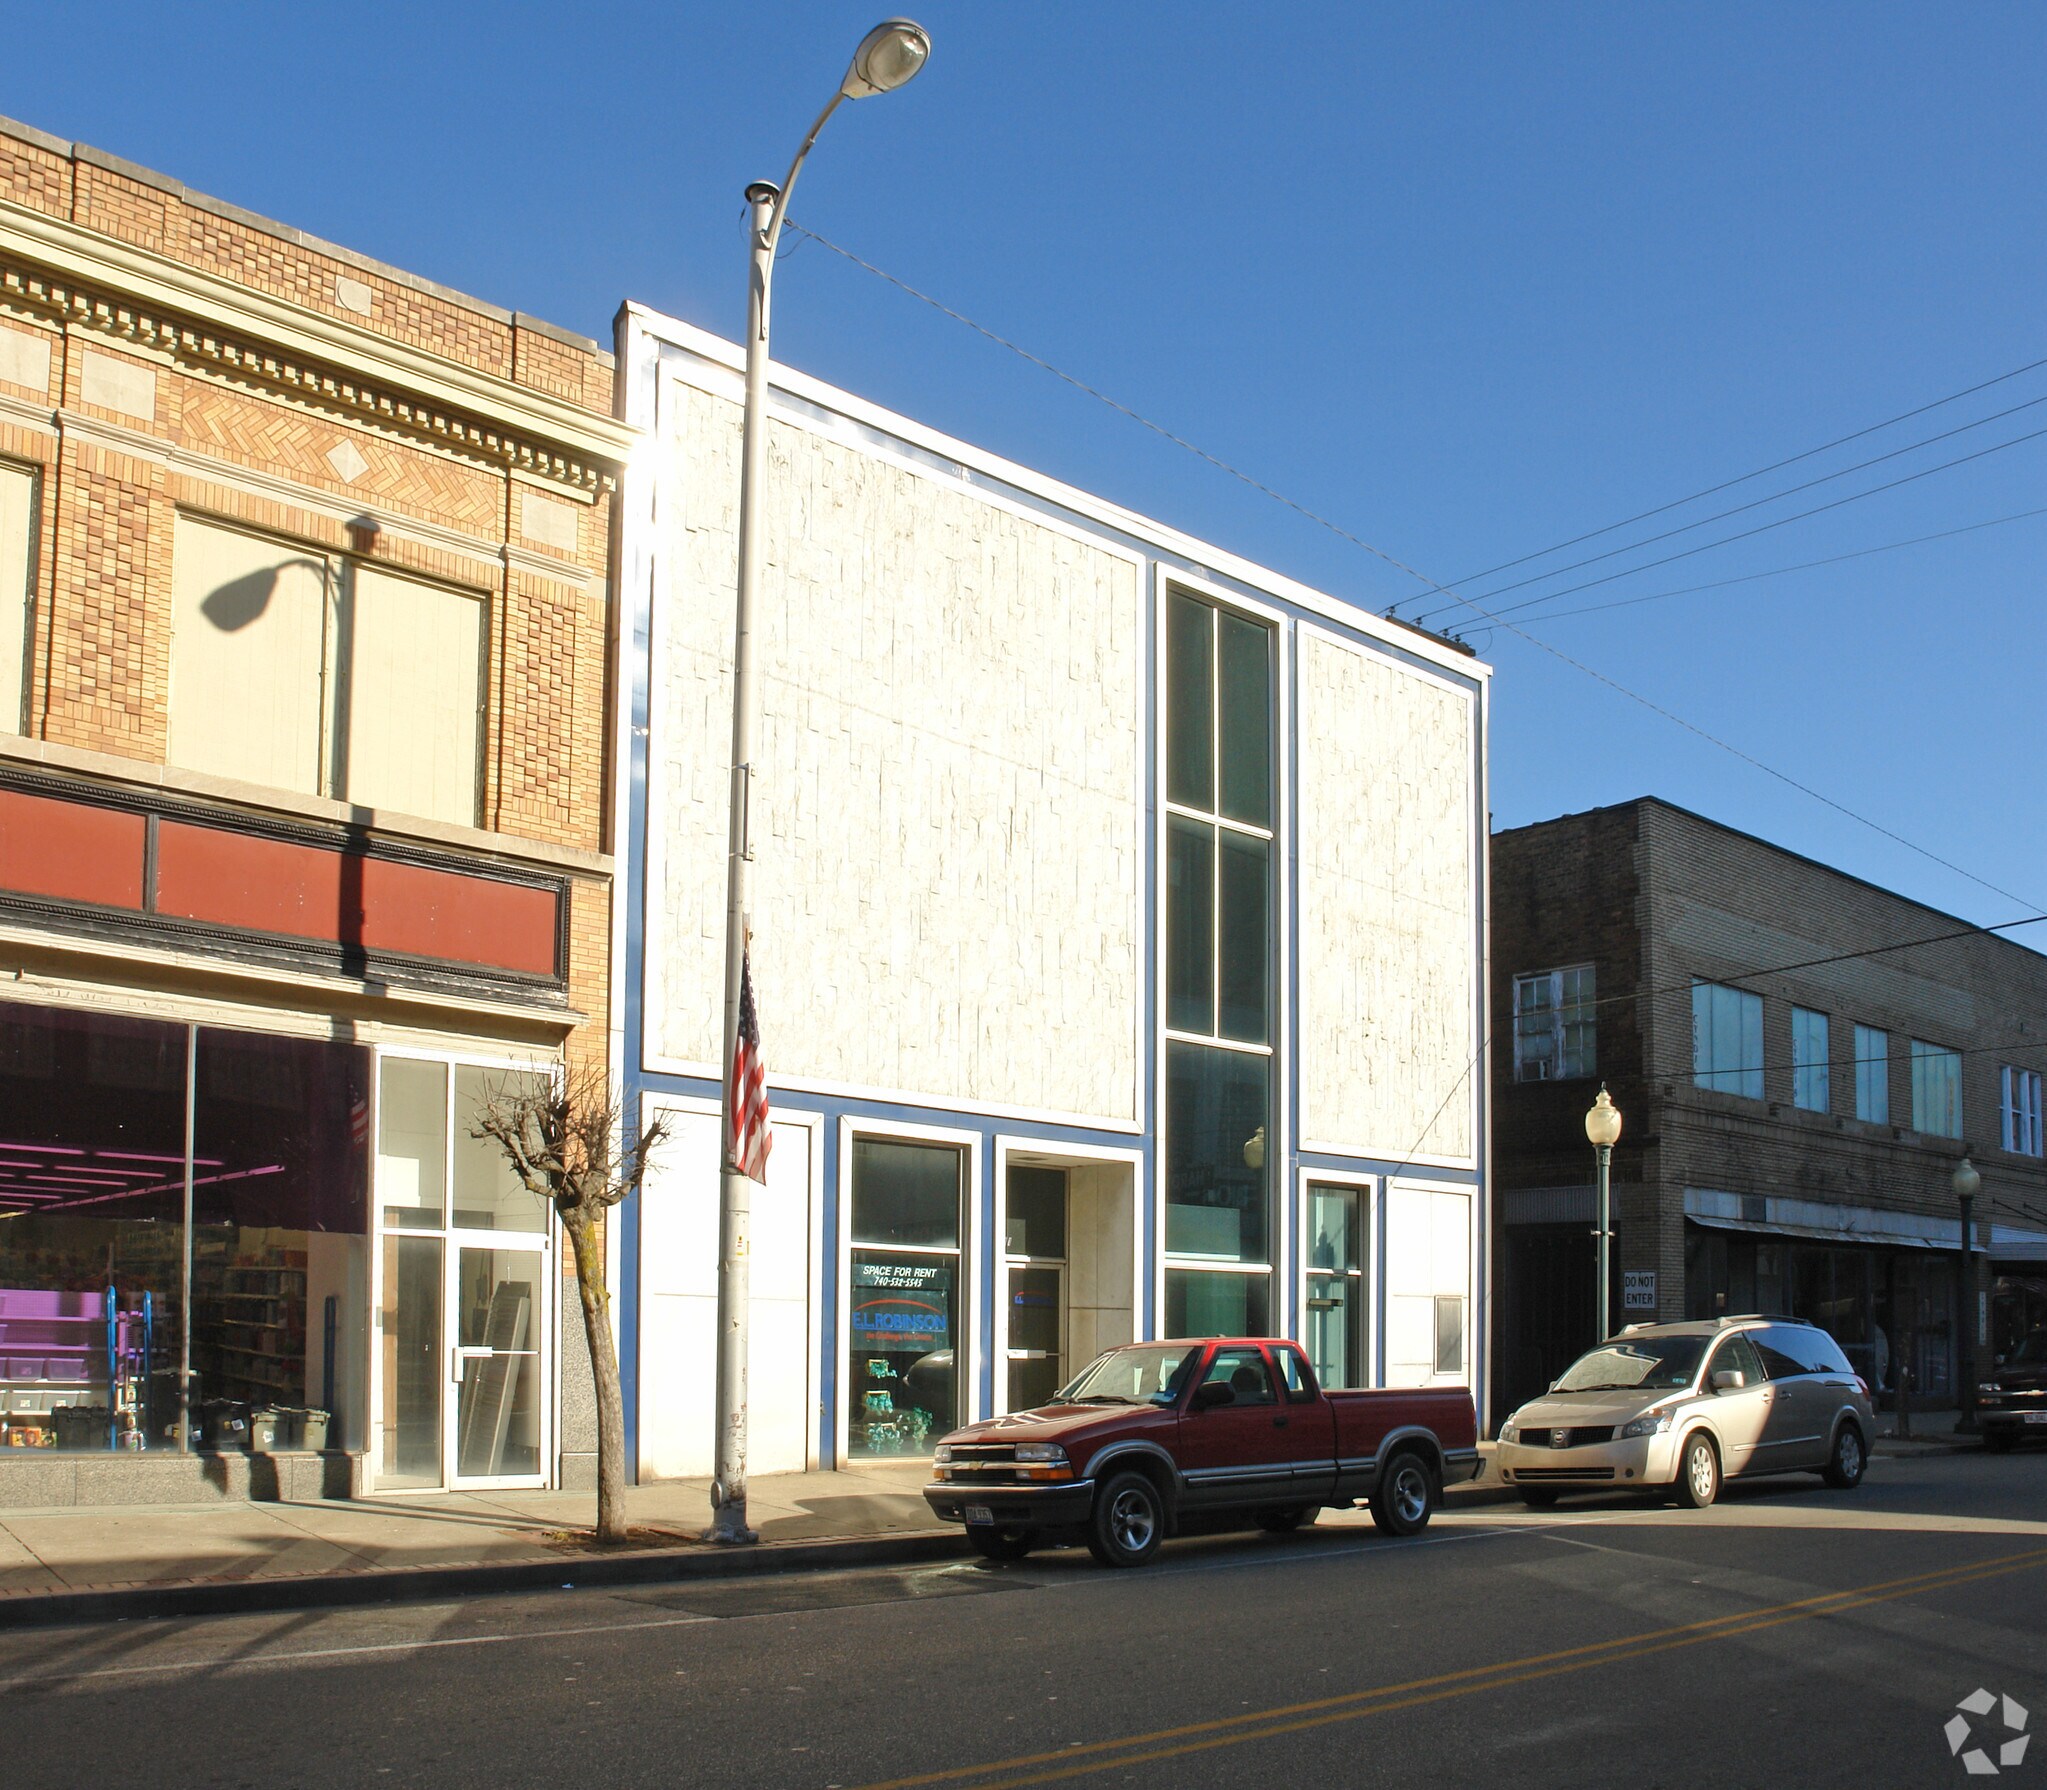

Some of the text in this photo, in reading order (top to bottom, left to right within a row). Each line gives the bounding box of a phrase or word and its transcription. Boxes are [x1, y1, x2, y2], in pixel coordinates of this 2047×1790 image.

[863, 1265, 937, 1278] SPACE FOR RENT
[874, 1276, 923, 1287] 740-532-5545
[1625, 1276, 1654, 1287] DO NOT
[1626, 1293, 1653, 1304] ENTER
